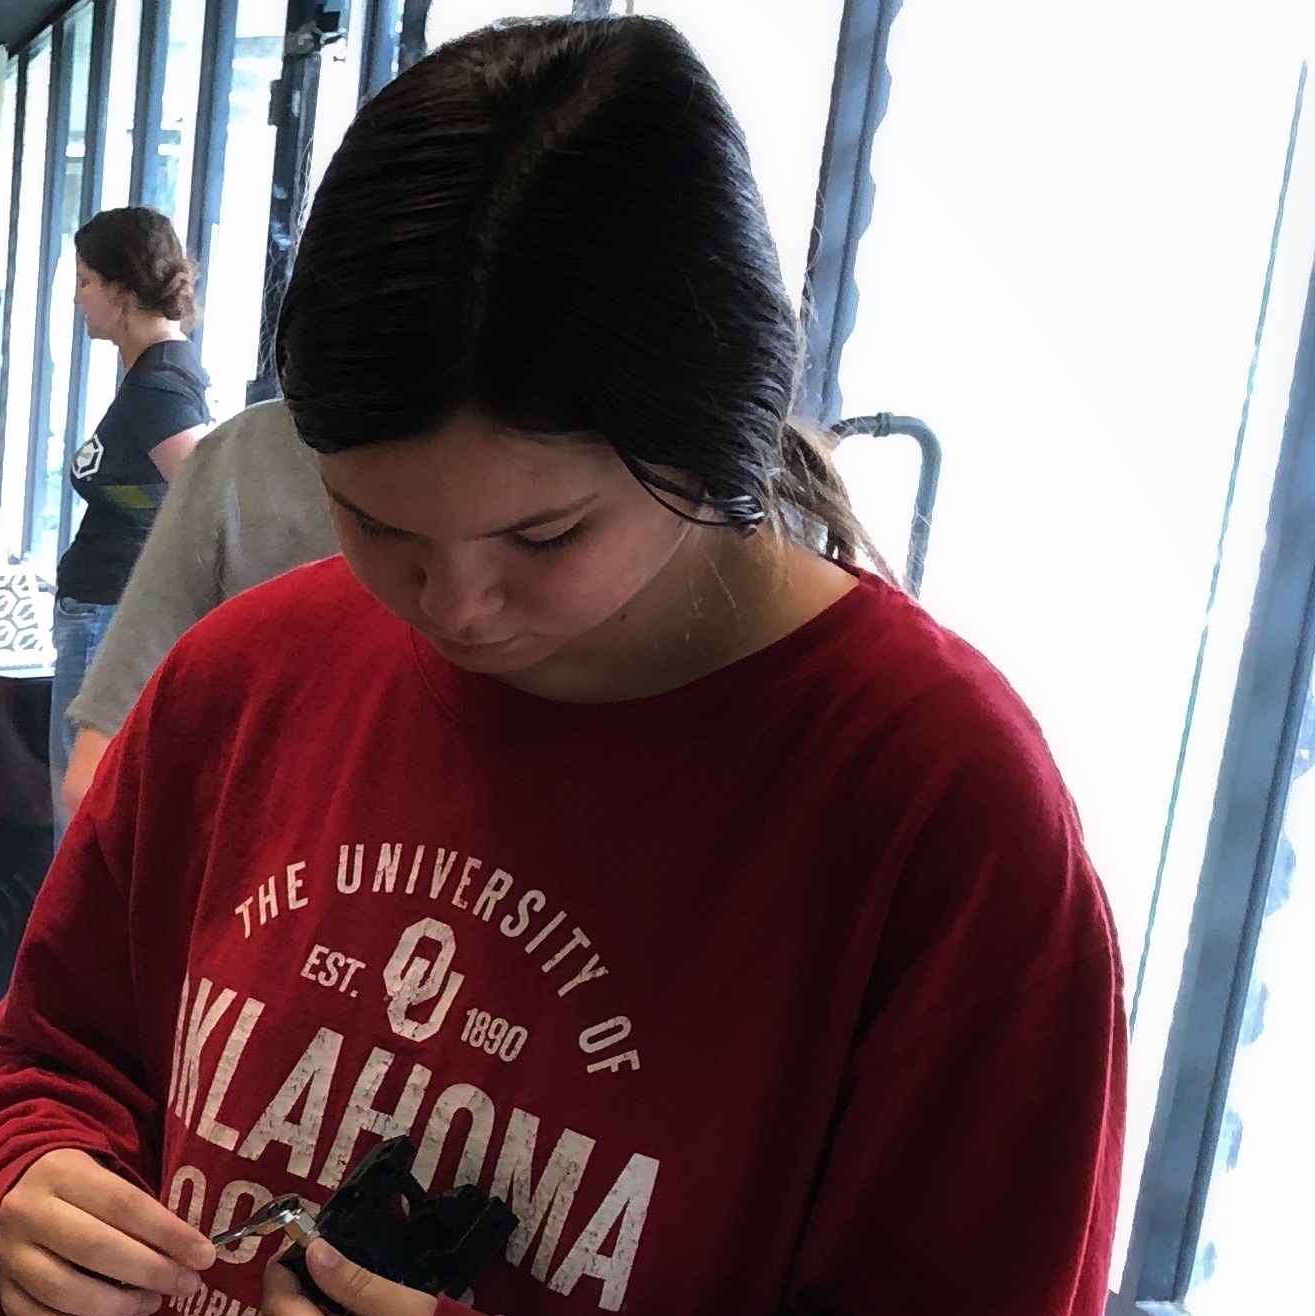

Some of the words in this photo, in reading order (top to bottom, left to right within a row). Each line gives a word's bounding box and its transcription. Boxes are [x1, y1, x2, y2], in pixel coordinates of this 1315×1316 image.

[235, 860, 309, 939] THE
[337, 842, 610, 998] UNIVERSITY
[577, 1014, 640, 1076] OF
[300, 943, 366, 999] EST.
[460, 1006, 528, 1063] 1890
